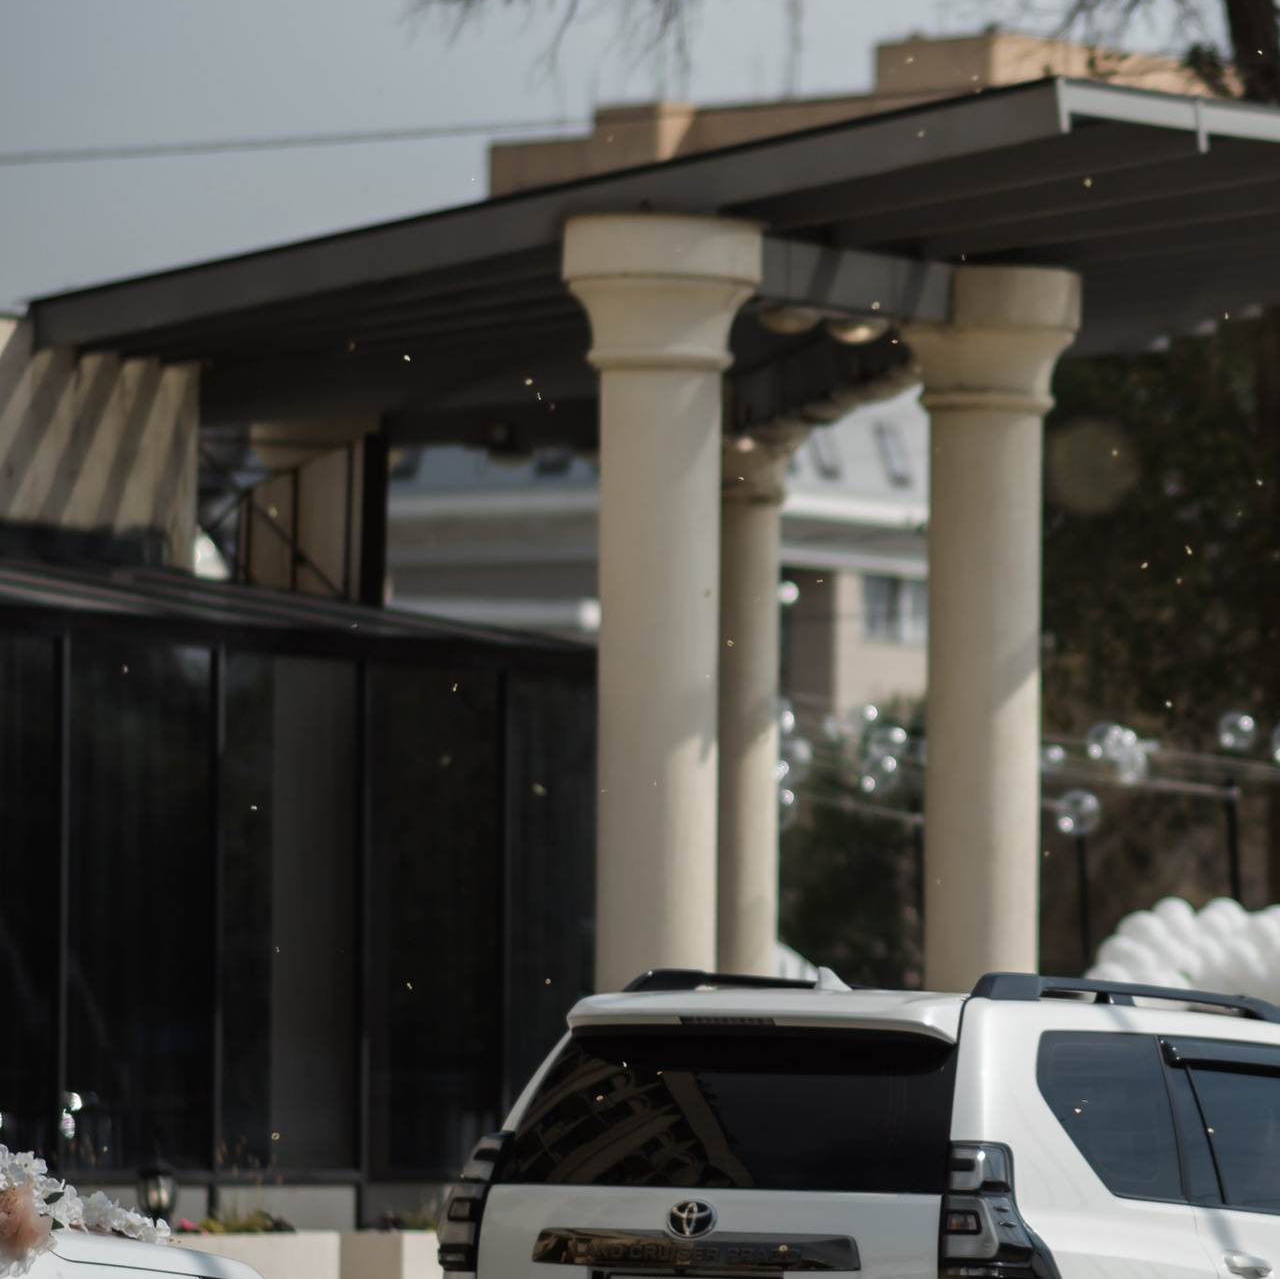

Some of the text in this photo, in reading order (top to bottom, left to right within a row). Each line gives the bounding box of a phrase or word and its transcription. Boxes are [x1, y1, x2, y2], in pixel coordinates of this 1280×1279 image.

[572, 1240, 802, 1262] LAND CRUISER PRADO
